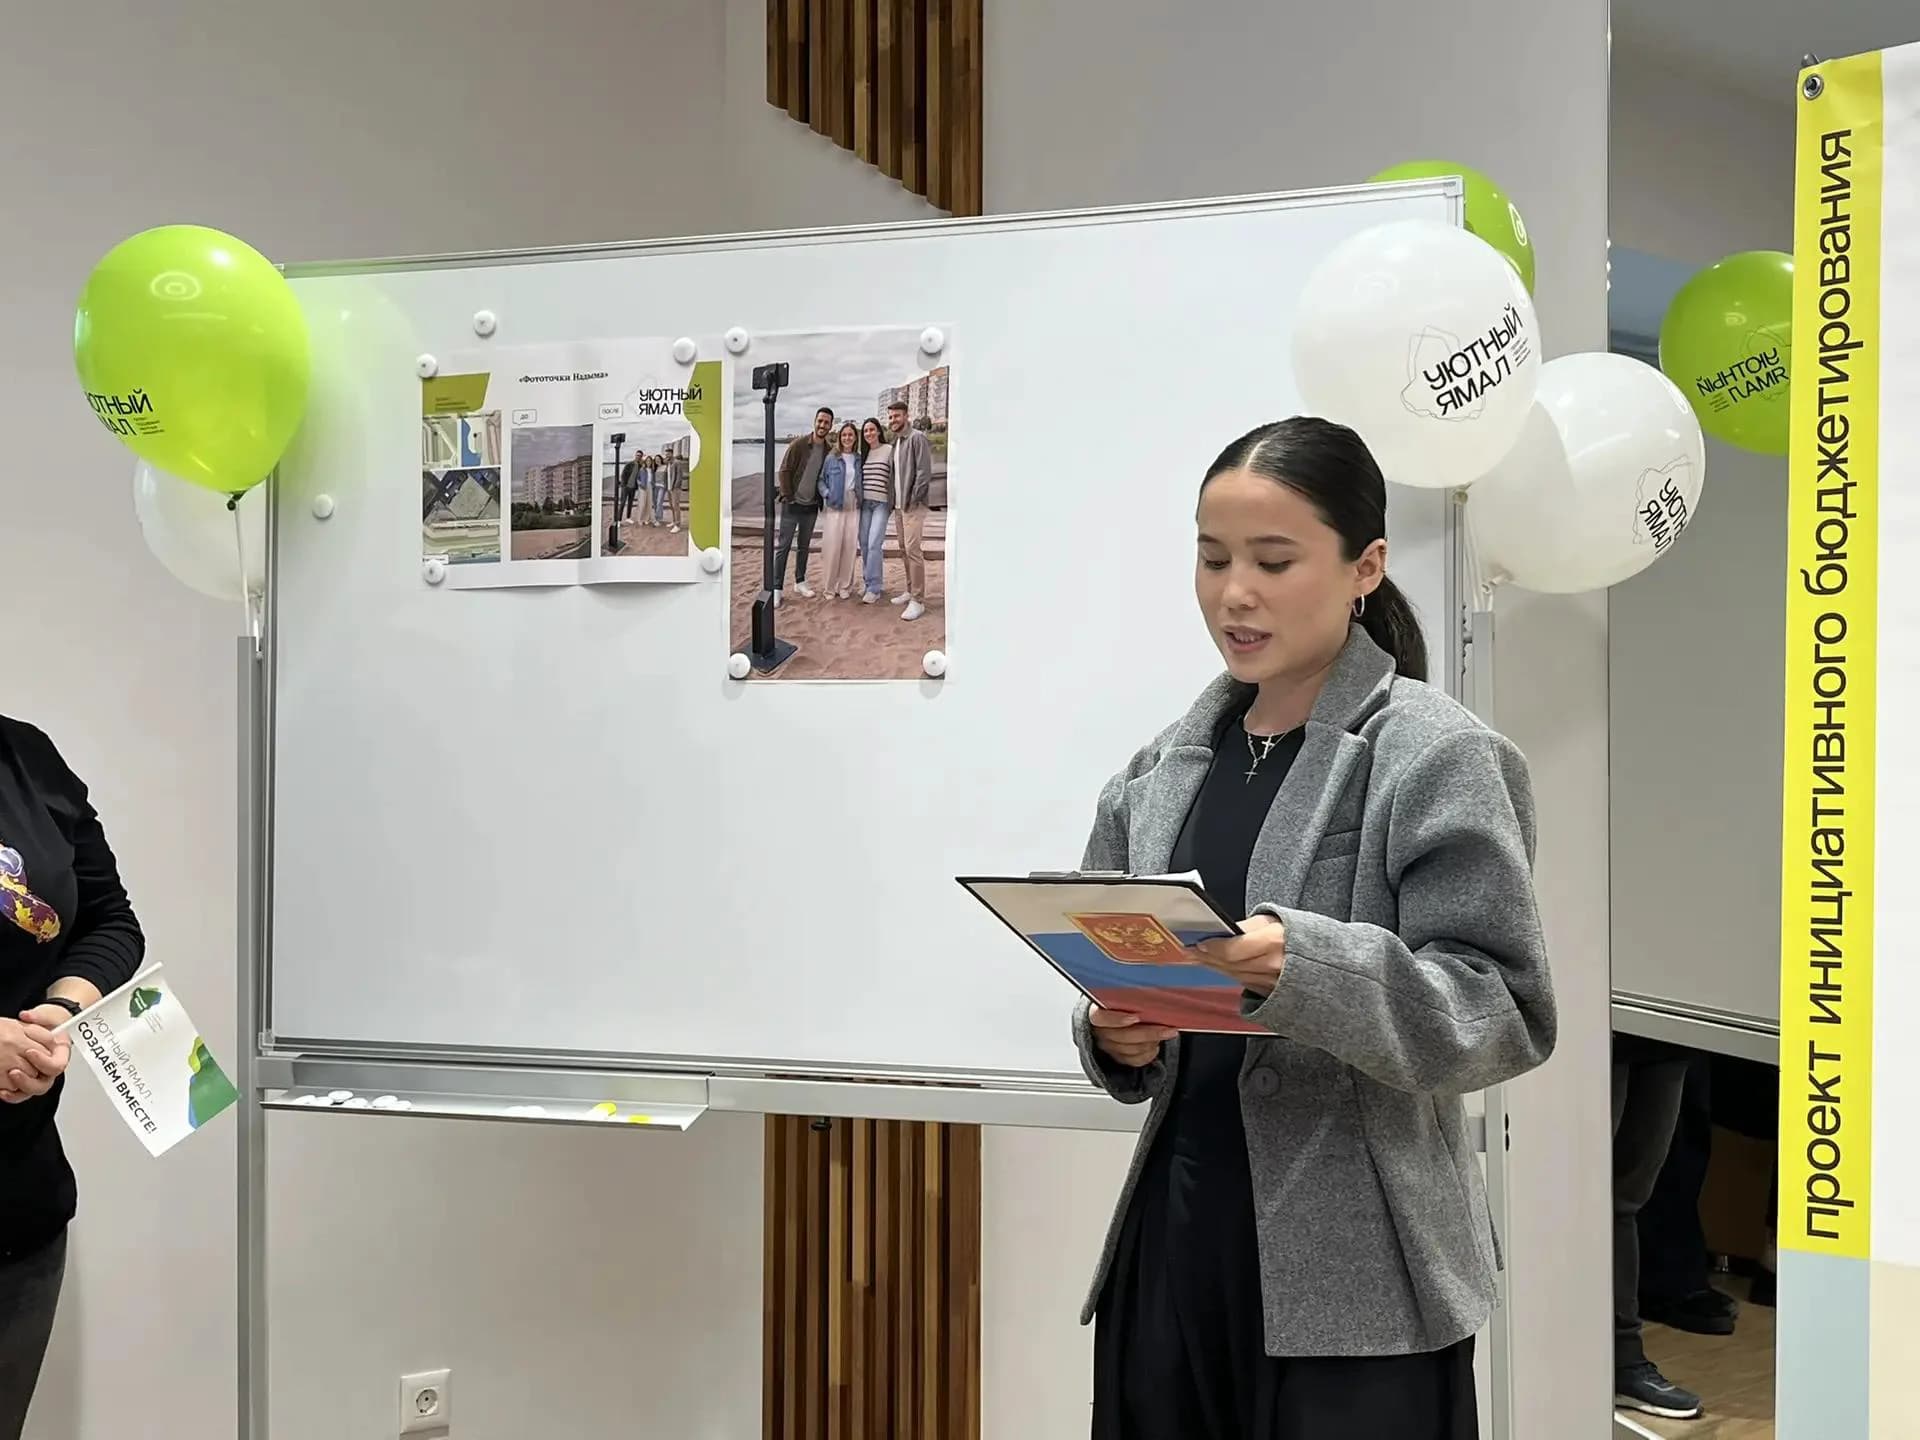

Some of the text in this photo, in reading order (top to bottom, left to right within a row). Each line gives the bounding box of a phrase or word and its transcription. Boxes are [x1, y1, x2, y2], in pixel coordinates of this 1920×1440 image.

[1423, 302, 1523, 390] УЮТНЫЙ
[84, 388, 153, 414] ЮТНЫЙ
[639, 383, 702, 401] УЮТНЫЙ
[639, 403, 681, 415] ЯМАЛ
[1436, 354, 1511, 415] ЯМАЛ
[1639, 500, 1671, 554] ЯМАЛ
[1660, 478, 1687, 540] УЮТН
[1801, 130, 1863, 1240] проект инициативного бюджетирования
[78, 1021, 121, 1083] СОЗДАЁМ
[116, 1081, 157, 1134] ВМЕСТЕ!
[92, 1012, 130, 1066] УЮТНЫЙ
[125, 1065, 151, 1100] ЯМАЛ
